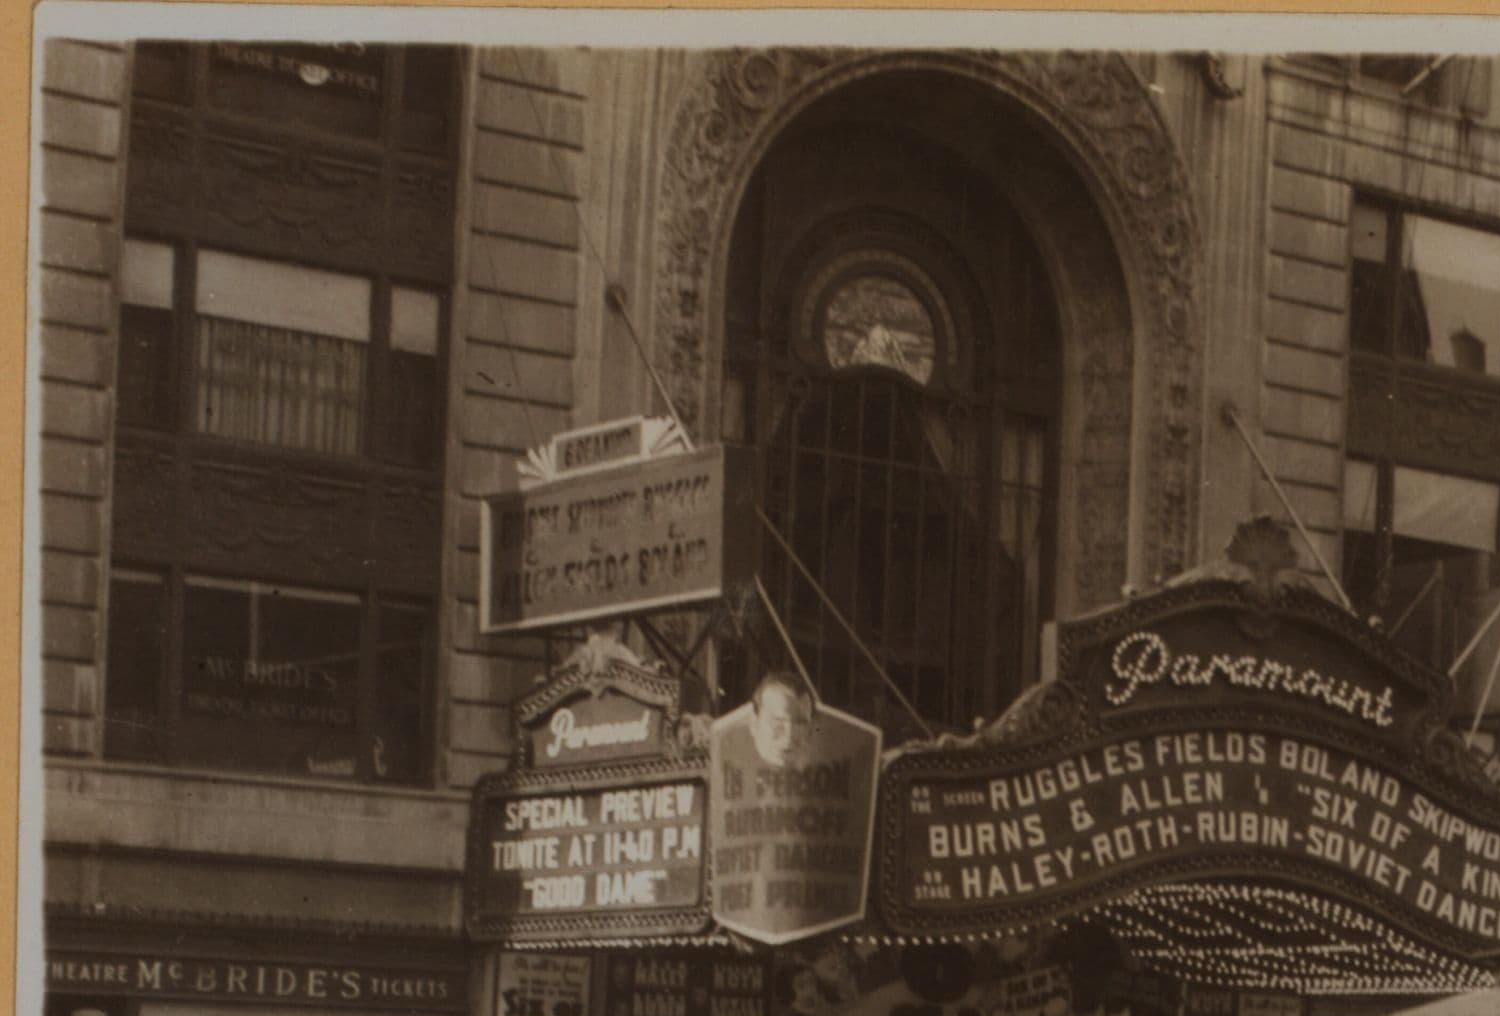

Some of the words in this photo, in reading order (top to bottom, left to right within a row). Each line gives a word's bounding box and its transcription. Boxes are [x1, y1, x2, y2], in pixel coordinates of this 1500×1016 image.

[1104, 630, 1393, 727] Paramount
[545, 707, 651, 759] Paramount
[987, 740, 1146, 814] RUGGLES
[1154, 731, 1267, 767] FIELDS
[1278, 738, 1402, 808] BOLAND
[504, 795, 590, 831] SPECIAL
[600, 784, 695, 825] PREVIEW
[927, 812, 1048, 859] BURNS
[1067, 796, 1096, 832] &
[1119, 770, 1225, 817] ALLEN
[1370, 810, 1412, 850] OF
[1421, 844, 1441, 876] A
[492, 835, 561, 871] TONITE
[567, 833, 597, 868] AT
[370, 976, 449, 998] TICKETS
